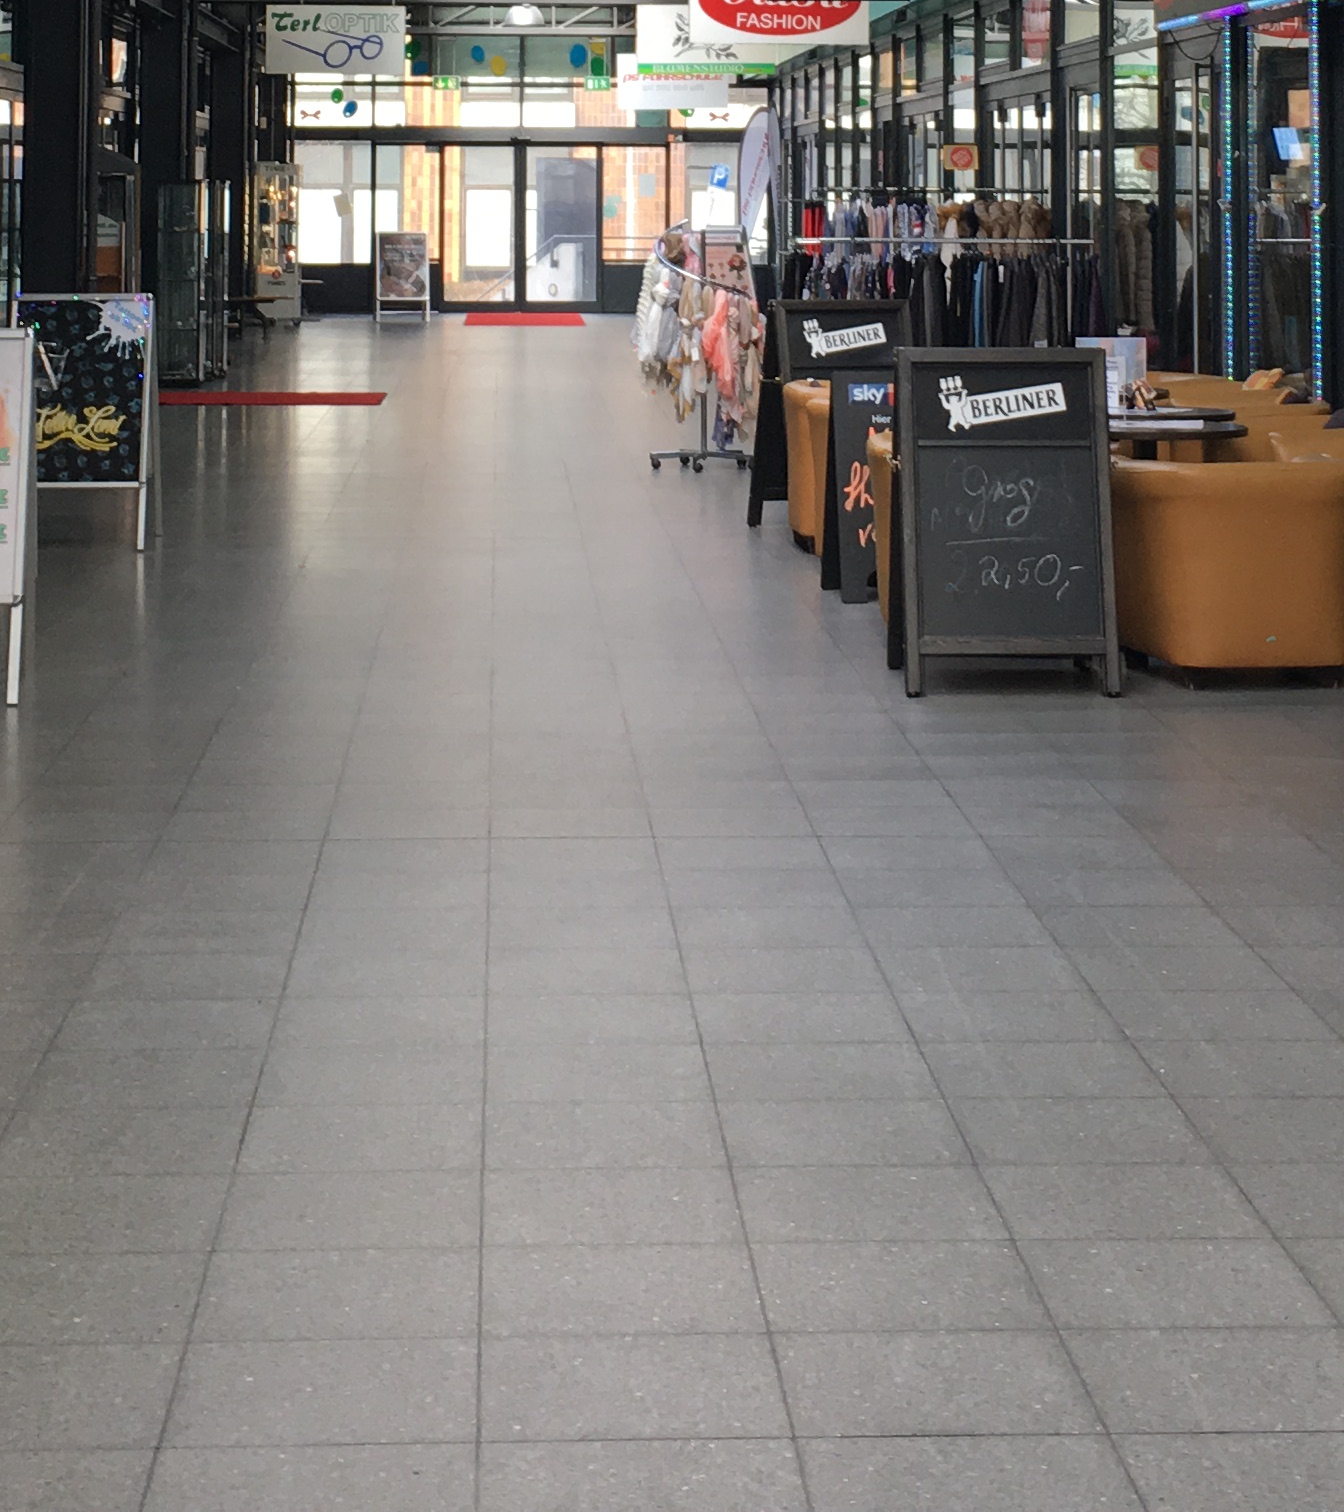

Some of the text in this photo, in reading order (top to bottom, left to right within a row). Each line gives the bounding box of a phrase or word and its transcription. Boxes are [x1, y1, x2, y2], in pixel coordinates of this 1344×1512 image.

[325, 12, 400, 33] OPTIK
[736, 12, 821, 30] FASHION
[652, 63, 745, 74] BLUMENSTUDIO
[823, 325, 883, 350] BERLINER
[853, 384, 885, 404] sky
[969, 388, 1060, 418] BERLINER
